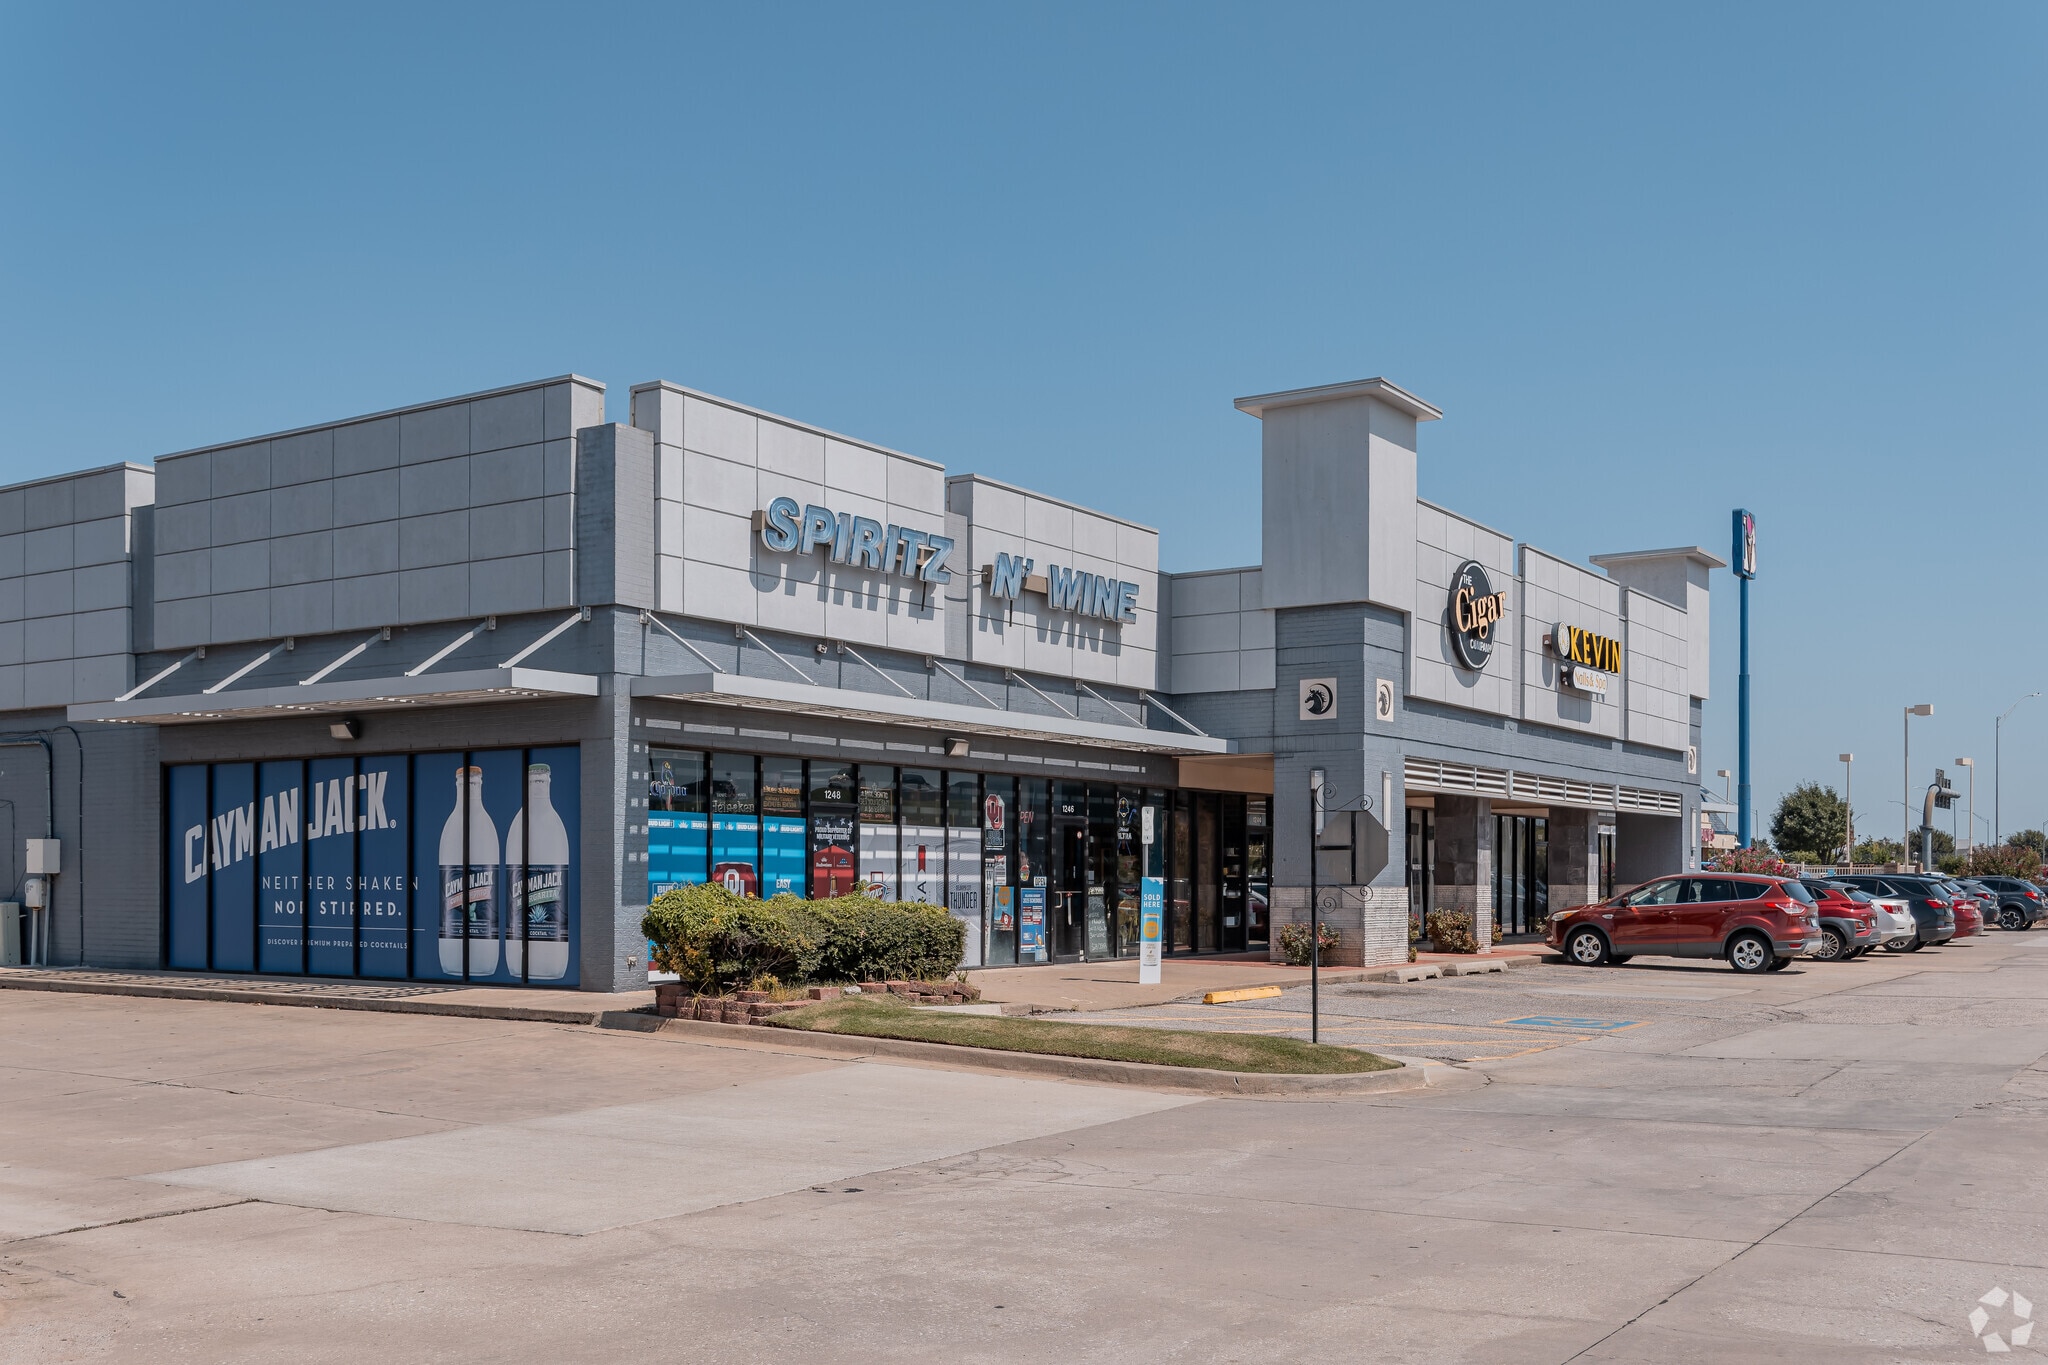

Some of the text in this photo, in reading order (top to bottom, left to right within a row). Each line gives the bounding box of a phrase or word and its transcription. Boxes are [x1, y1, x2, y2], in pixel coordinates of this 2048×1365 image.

[762, 497, 954, 585] SPIRITZ
[1047, 564, 1139, 624] WINE
[1463, 574, 1473, 586] THE
[1455, 586, 1507, 639] Cigar
[1570, 625, 1622, 675] KEVIN
[824, 790, 841, 800] 1248
[1062, 804, 1075, 813] 1246
[1020, 811, 1034, 824] PEN
[185, 787, 299, 884] CAYMAN
[445, 873, 475, 898] CAYMN
[475, 871, 494, 887] JACK
[543, 871, 562, 889] JACK
[776, 879, 791, 889] EASY
[1035, 877, 1046, 887] OPEN
[949, 891, 978, 909] THUNDER
[267, 938, 298, 946] DISCOVER
[333, 940, 368, 948] PREPAED
